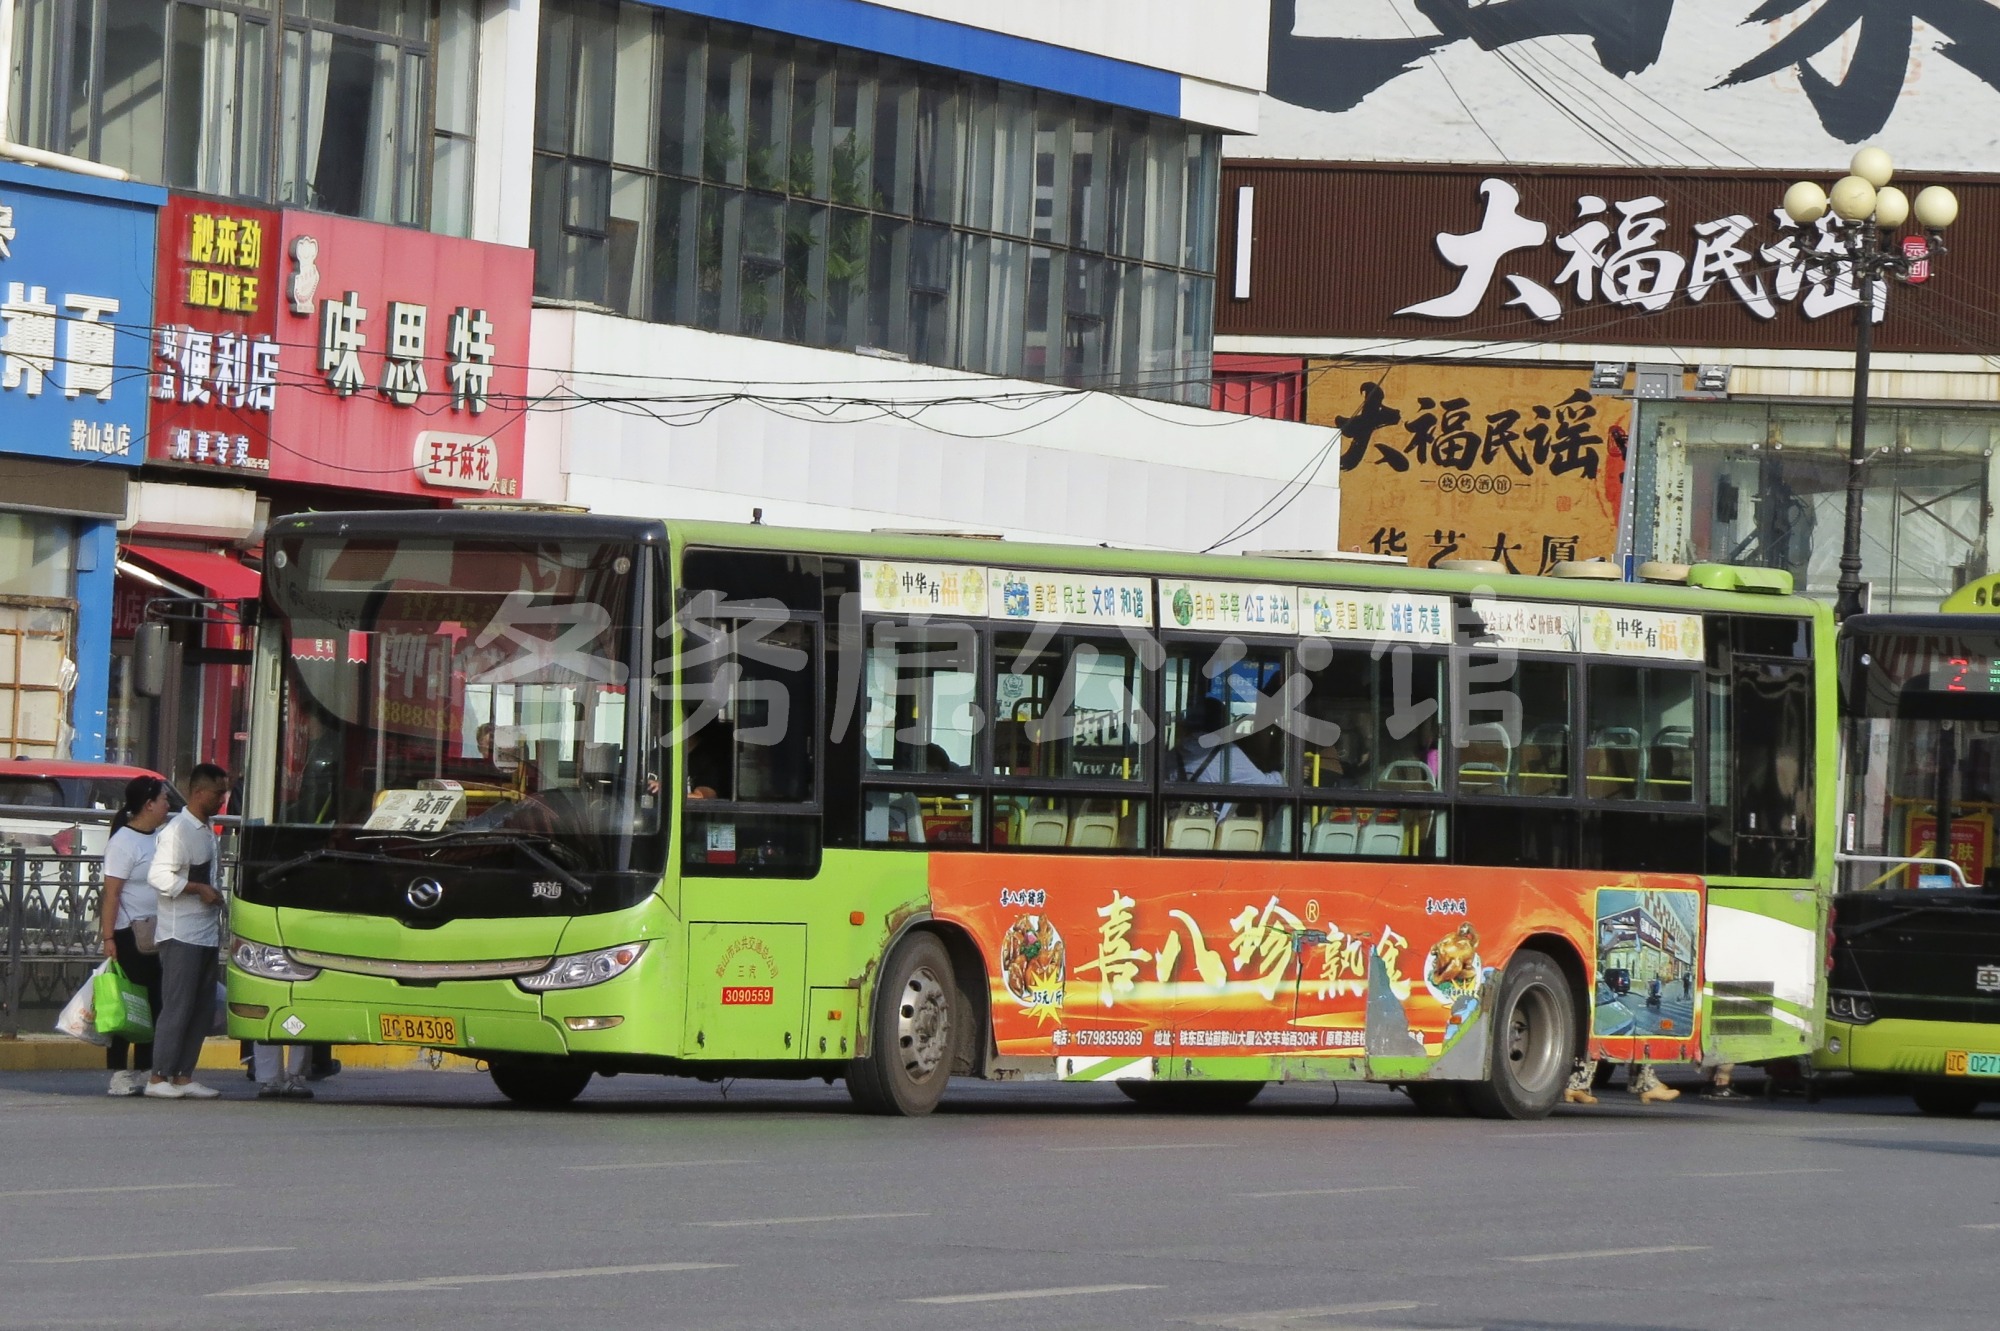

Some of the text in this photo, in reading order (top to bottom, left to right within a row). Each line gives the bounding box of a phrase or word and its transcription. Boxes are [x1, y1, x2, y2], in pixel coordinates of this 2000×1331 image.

[192, 214, 262, 268] 秒来劲
[1393, 177, 1887, 323] 大福民谣
[181, 326, 281, 411] 便利店
[322, 290, 495, 414] 味思特
[71, 419, 131, 457] 鞍山总店
[177, 428, 249, 466] 烟草专卖
[1335, 381, 1604, 480] 大福民谣
[428, 441, 491, 482] 王子麻花
[1439, 474, 1510, 493] 烧烤酒馆
[1368, 526, 1581, 570] 华艺大厦
[902, 570, 960, 607] 中华有福
[1034, 582, 1144, 618] 富强 民主 文明 和谐
[1195, 591, 1290, 624] 自由 平等 公正 法治
[1335, 600, 1441, 635] 爱国 敬业 诚信 友善
[1616, 617, 1678, 651] 中华有福
[1947, 658, 1969, 691] 2
[411, 795, 454, 815] 站前
[725, 988, 771, 1003] 3090559
[286, 1019, 303, 1031] LNG
